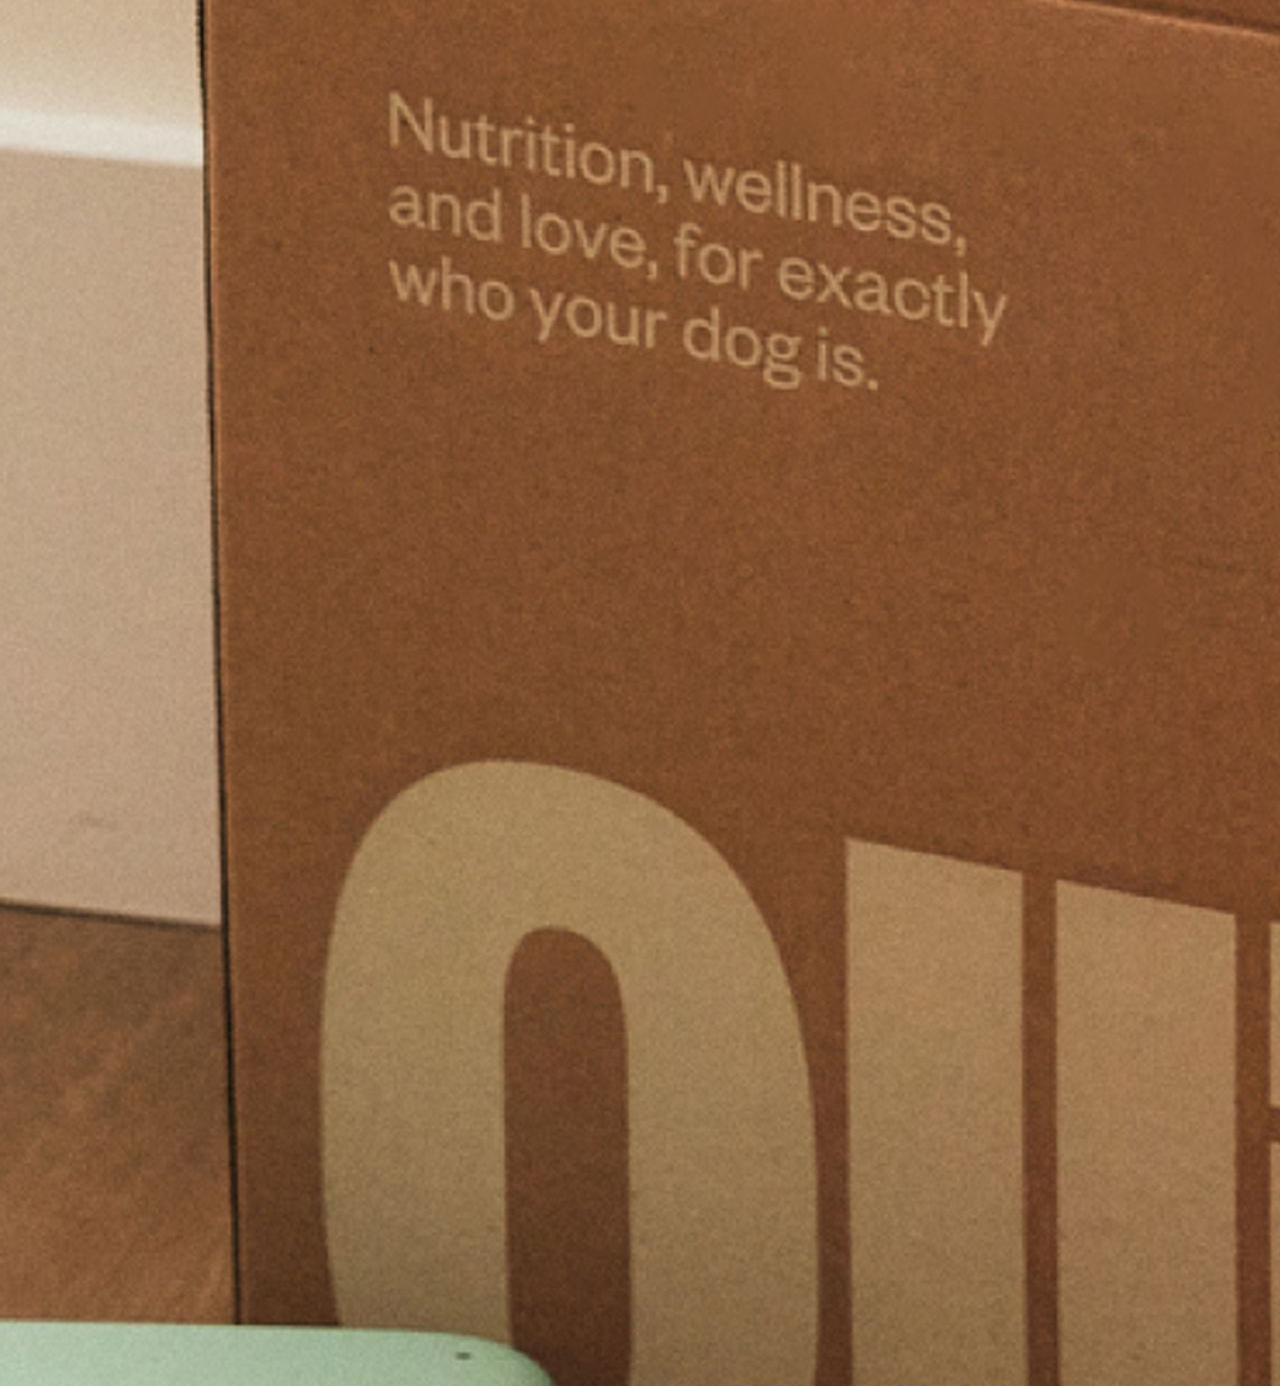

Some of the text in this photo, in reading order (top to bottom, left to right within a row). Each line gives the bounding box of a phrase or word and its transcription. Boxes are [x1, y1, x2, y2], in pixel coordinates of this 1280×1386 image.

[387, 90, 967, 257] Nutrition, wellness,
[387, 183, 1008, 347] and love, for exactly
[387, 256, 880, 391] who your dog is.
